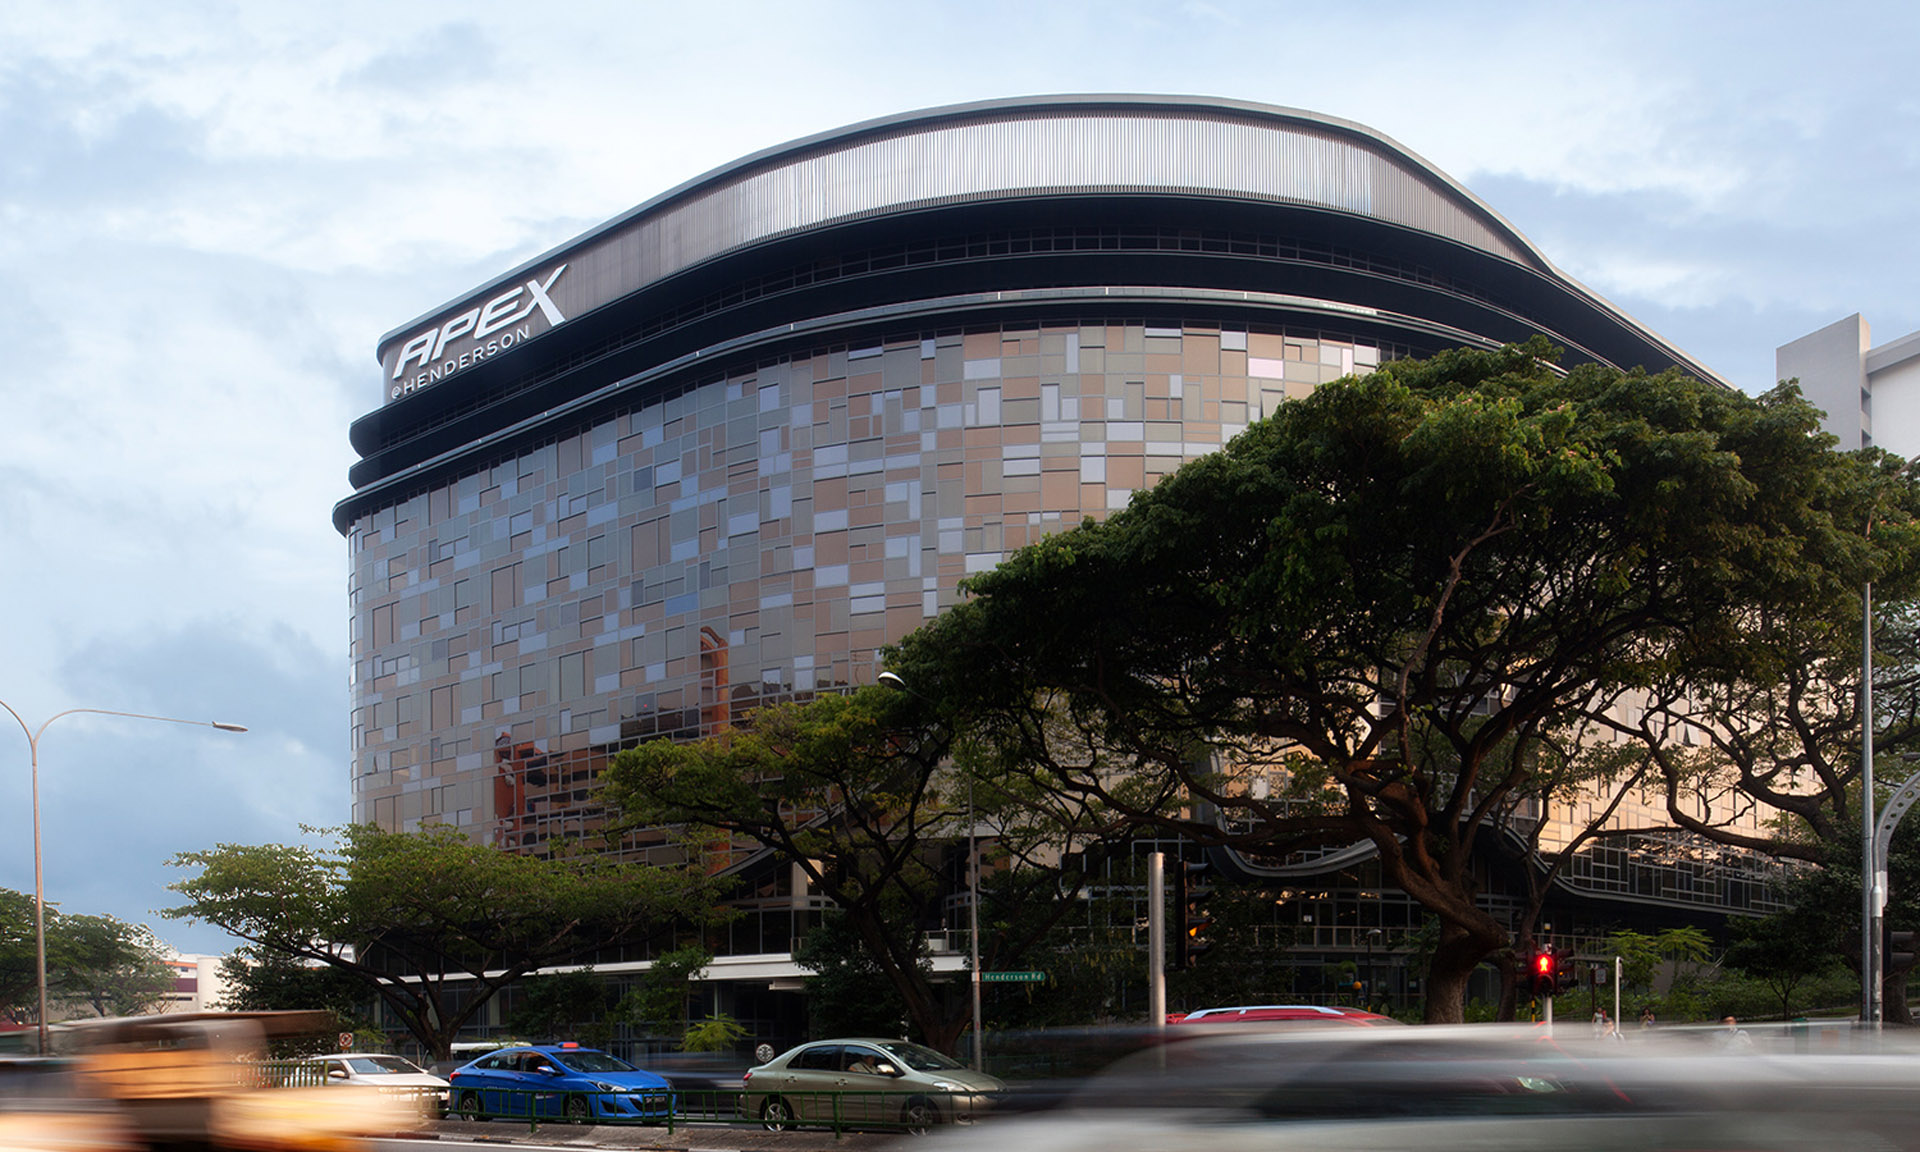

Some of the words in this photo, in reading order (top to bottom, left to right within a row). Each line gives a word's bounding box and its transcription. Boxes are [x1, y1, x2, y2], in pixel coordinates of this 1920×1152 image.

[392, 263, 568, 380] APEX
[391, 324, 530, 399] @HENDERSON
[985, 973, 1028, 981] Henderson
[1031, 972, 1042, 981] Rd
